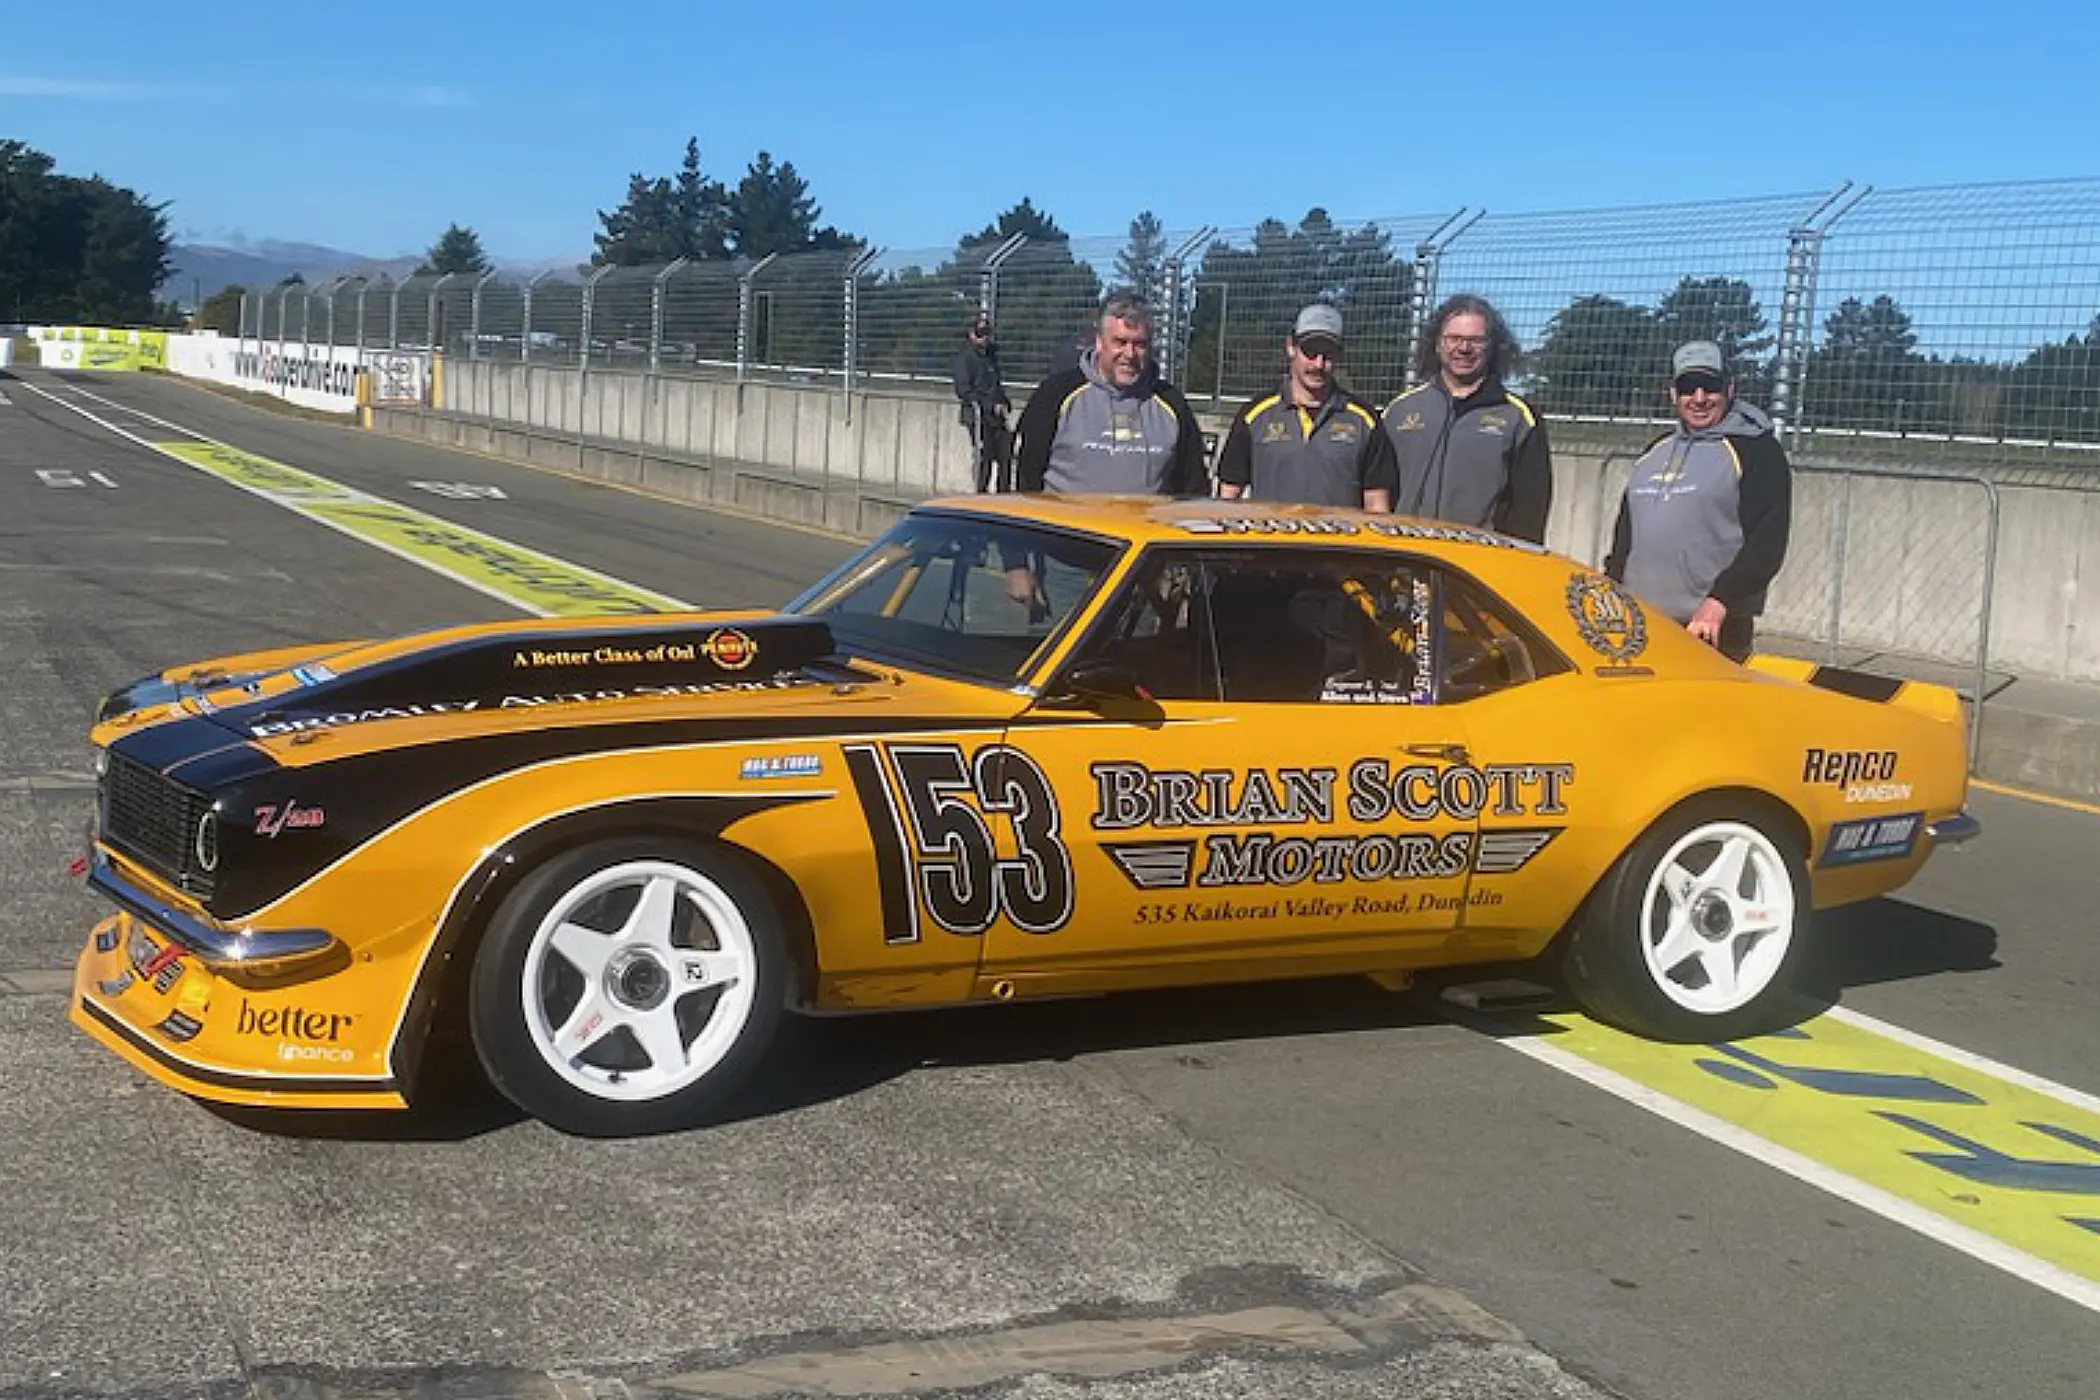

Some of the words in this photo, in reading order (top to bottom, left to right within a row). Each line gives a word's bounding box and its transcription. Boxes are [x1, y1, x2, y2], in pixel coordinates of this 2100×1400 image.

[513, 652, 528, 668] A
[533, 649, 591, 666] Better
[593, 648, 643, 663] Class
[645, 644, 664, 661] of
[667, 643, 694, 660] Oil
[1803, 748, 1898, 790] Repco
[1090, 761, 1337, 829] BRIAN
[1348, 757, 1574, 822] SCOTT
[840, 743, 1075, 945] 153
[1197, 831, 1472, 886] MOTORS
[1134, 903, 1176, 924] 535
[1182, 900, 1277, 923] Kaikorai
[1285, 896, 1347, 920] Valley
[1352, 892, 1410, 914] Road,
[236, 997, 353, 1041] better
